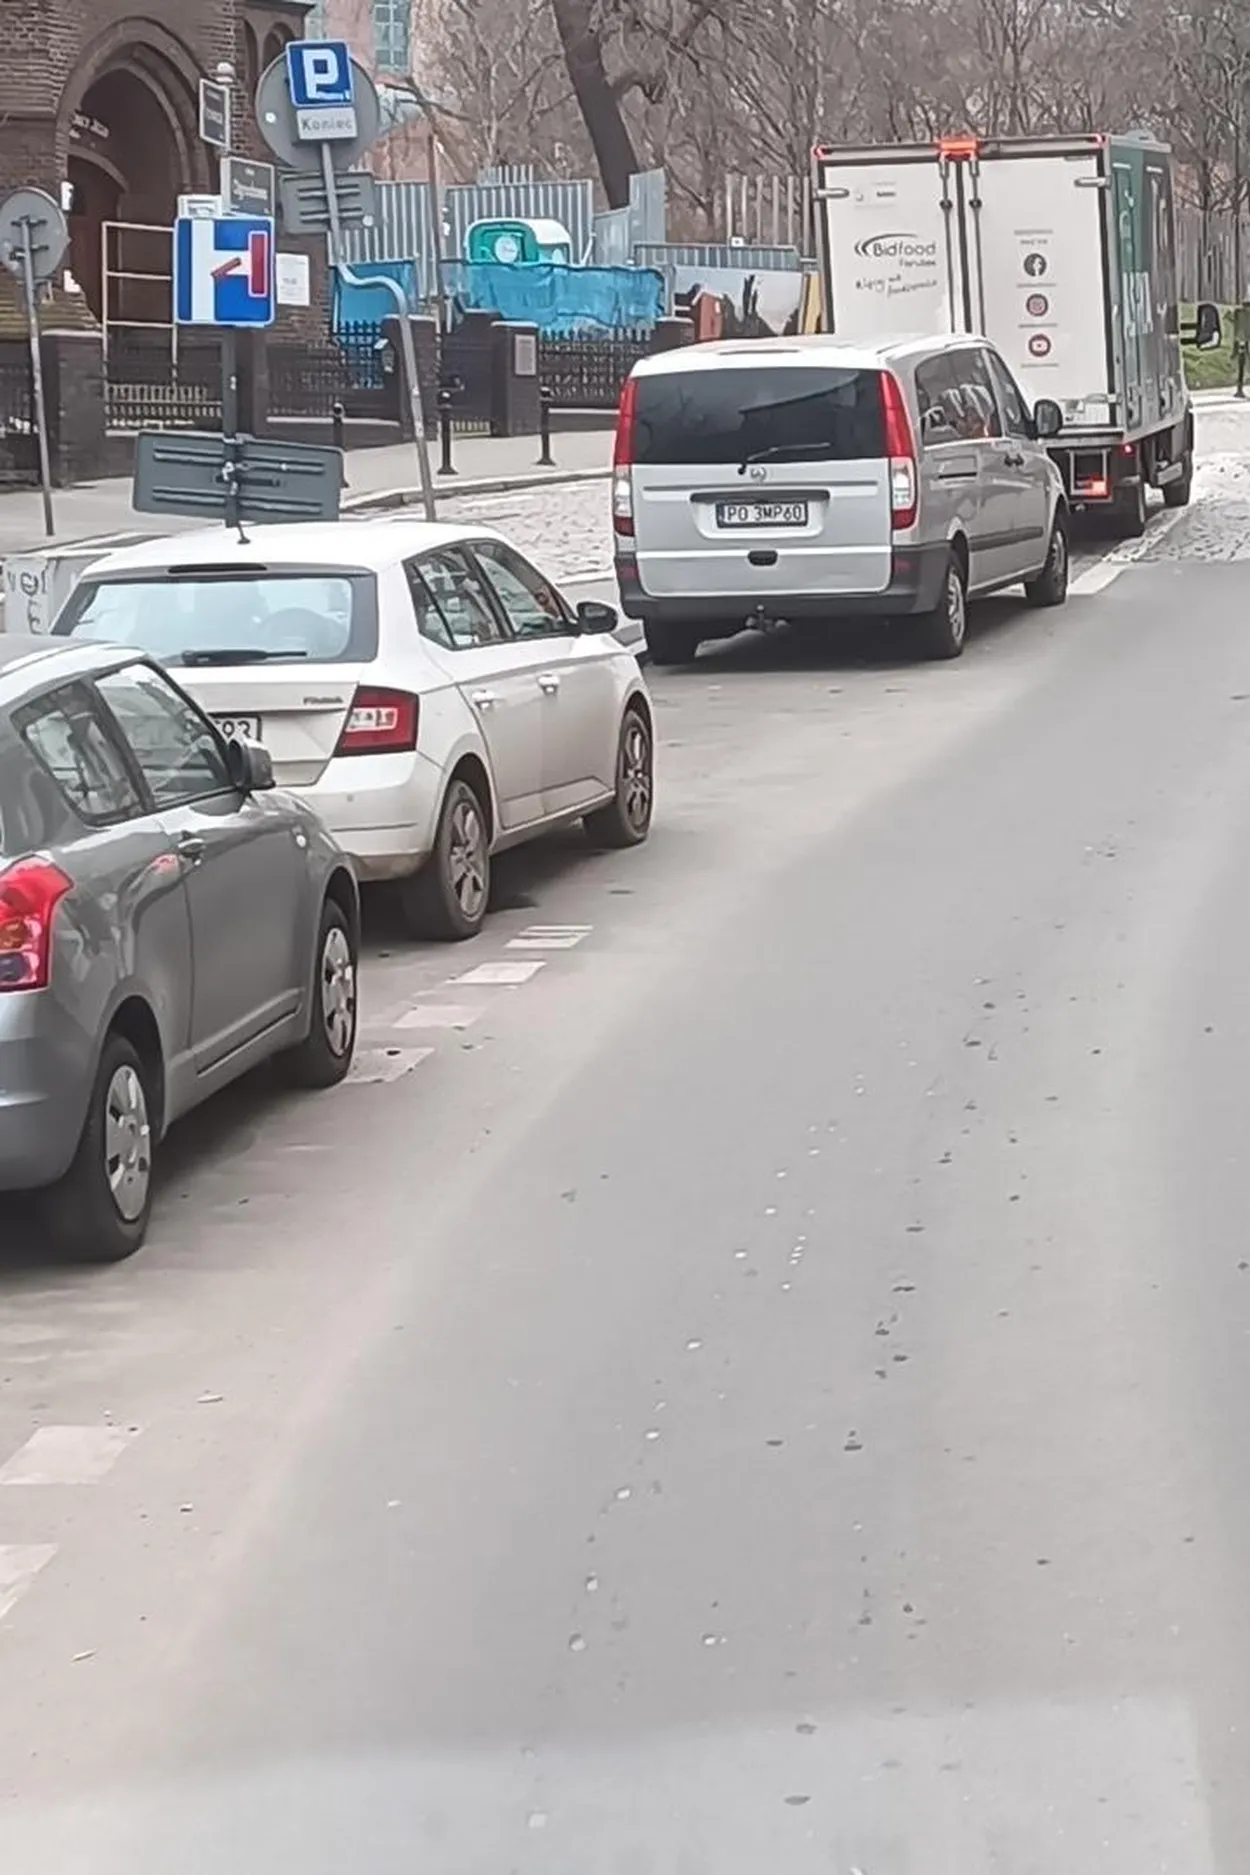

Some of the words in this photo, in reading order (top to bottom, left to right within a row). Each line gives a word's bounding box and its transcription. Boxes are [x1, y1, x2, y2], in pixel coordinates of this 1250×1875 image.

[302, 48, 339, 99] P
[302, 116, 353, 132] Koniec
[872, 240, 937, 257] Bidfood
[727, 506, 749, 521] PO
